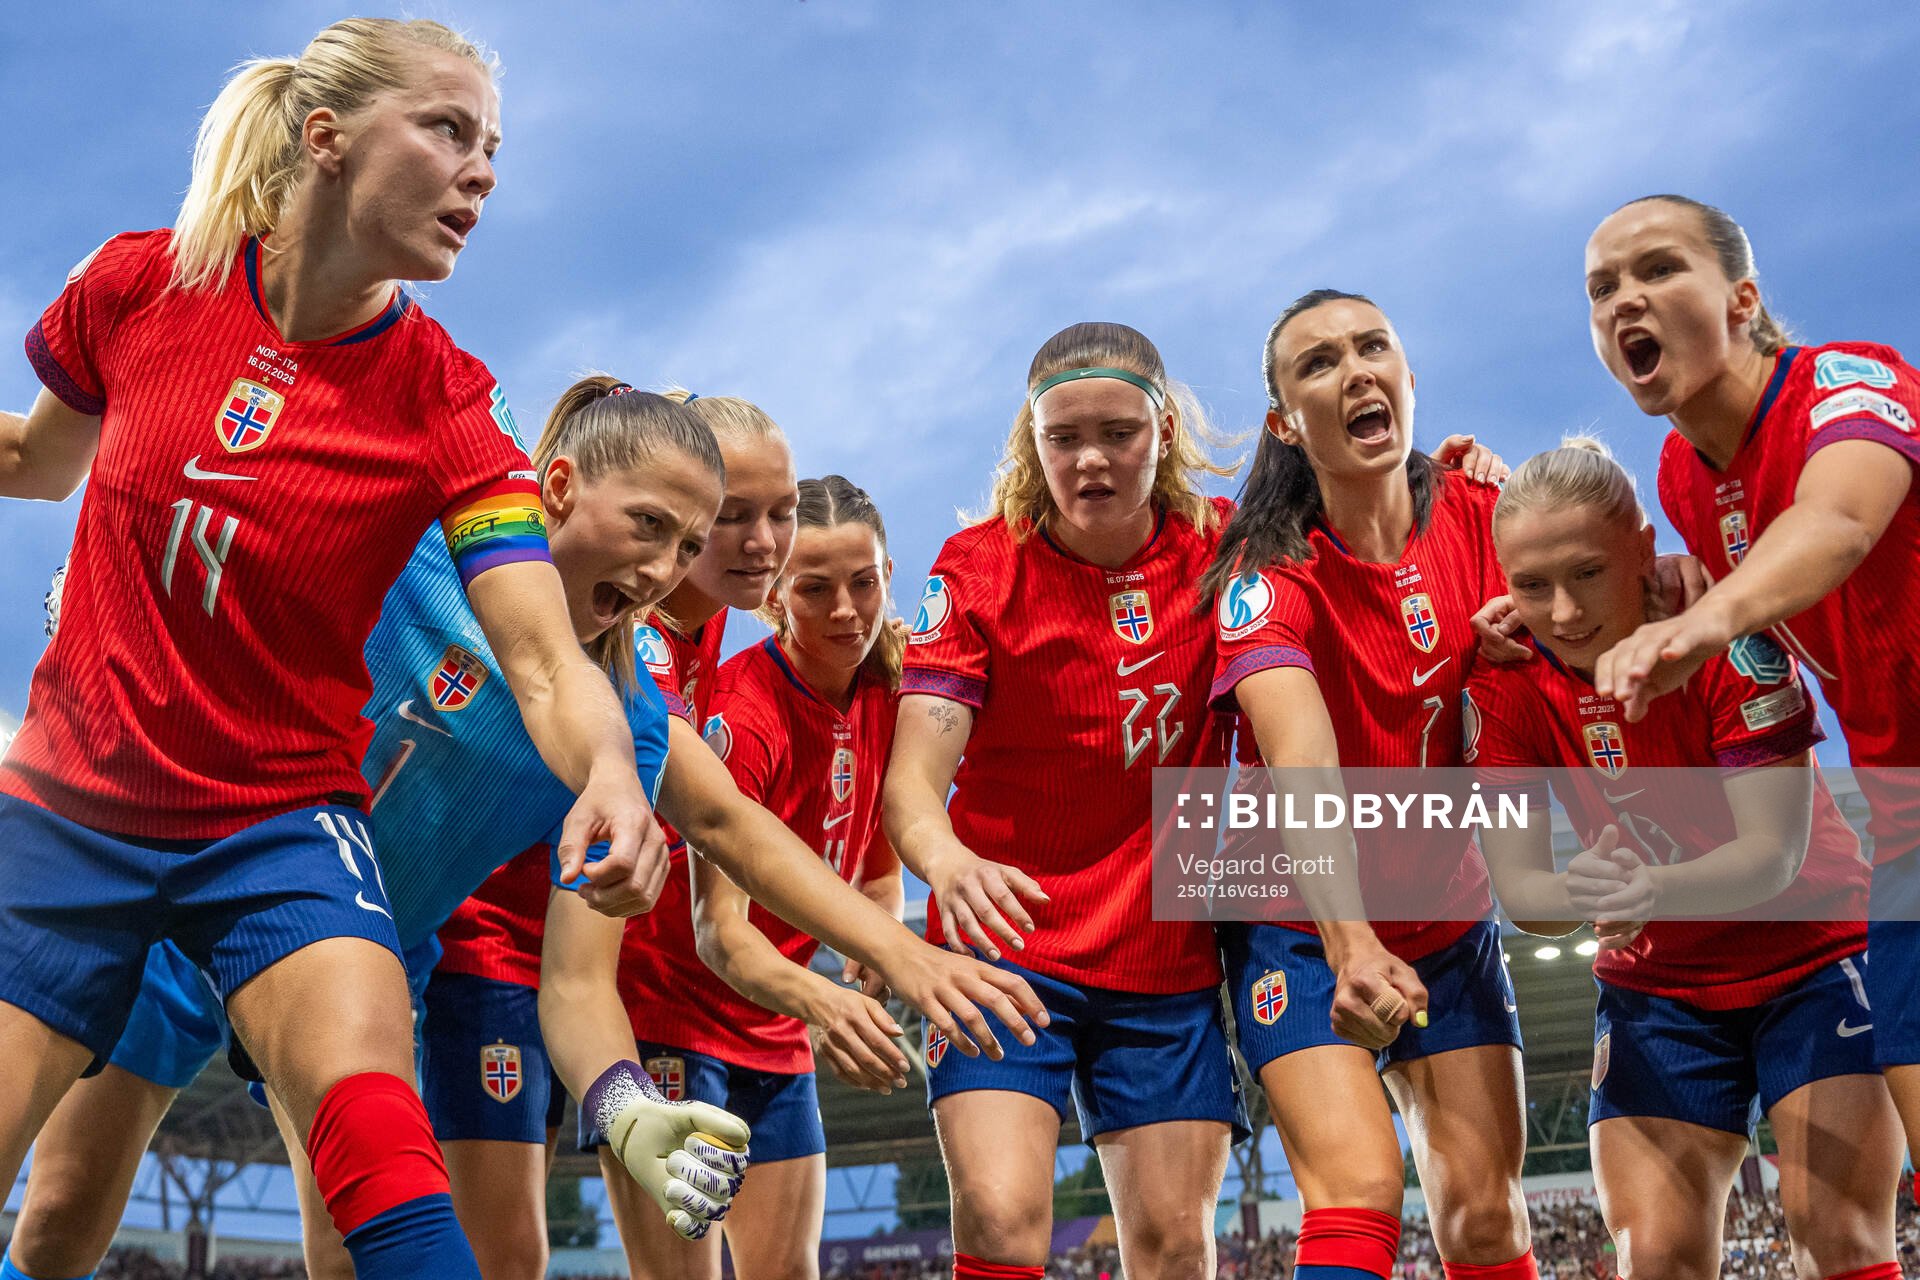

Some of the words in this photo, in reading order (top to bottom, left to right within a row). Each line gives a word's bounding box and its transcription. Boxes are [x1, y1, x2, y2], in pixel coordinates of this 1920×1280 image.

[247, 355, 295, 385] 16.07.2025
[256, 345, 277, 360] NOR
[282, 358, 298, 372] ITA
[160, 498, 240, 619] 14
[1106, 573, 1145, 584] 16.07.2025
[1118, 682, 1184, 770] 22
[1420, 695, 1444, 776] 7
[313, 812, 388, 903] 14
